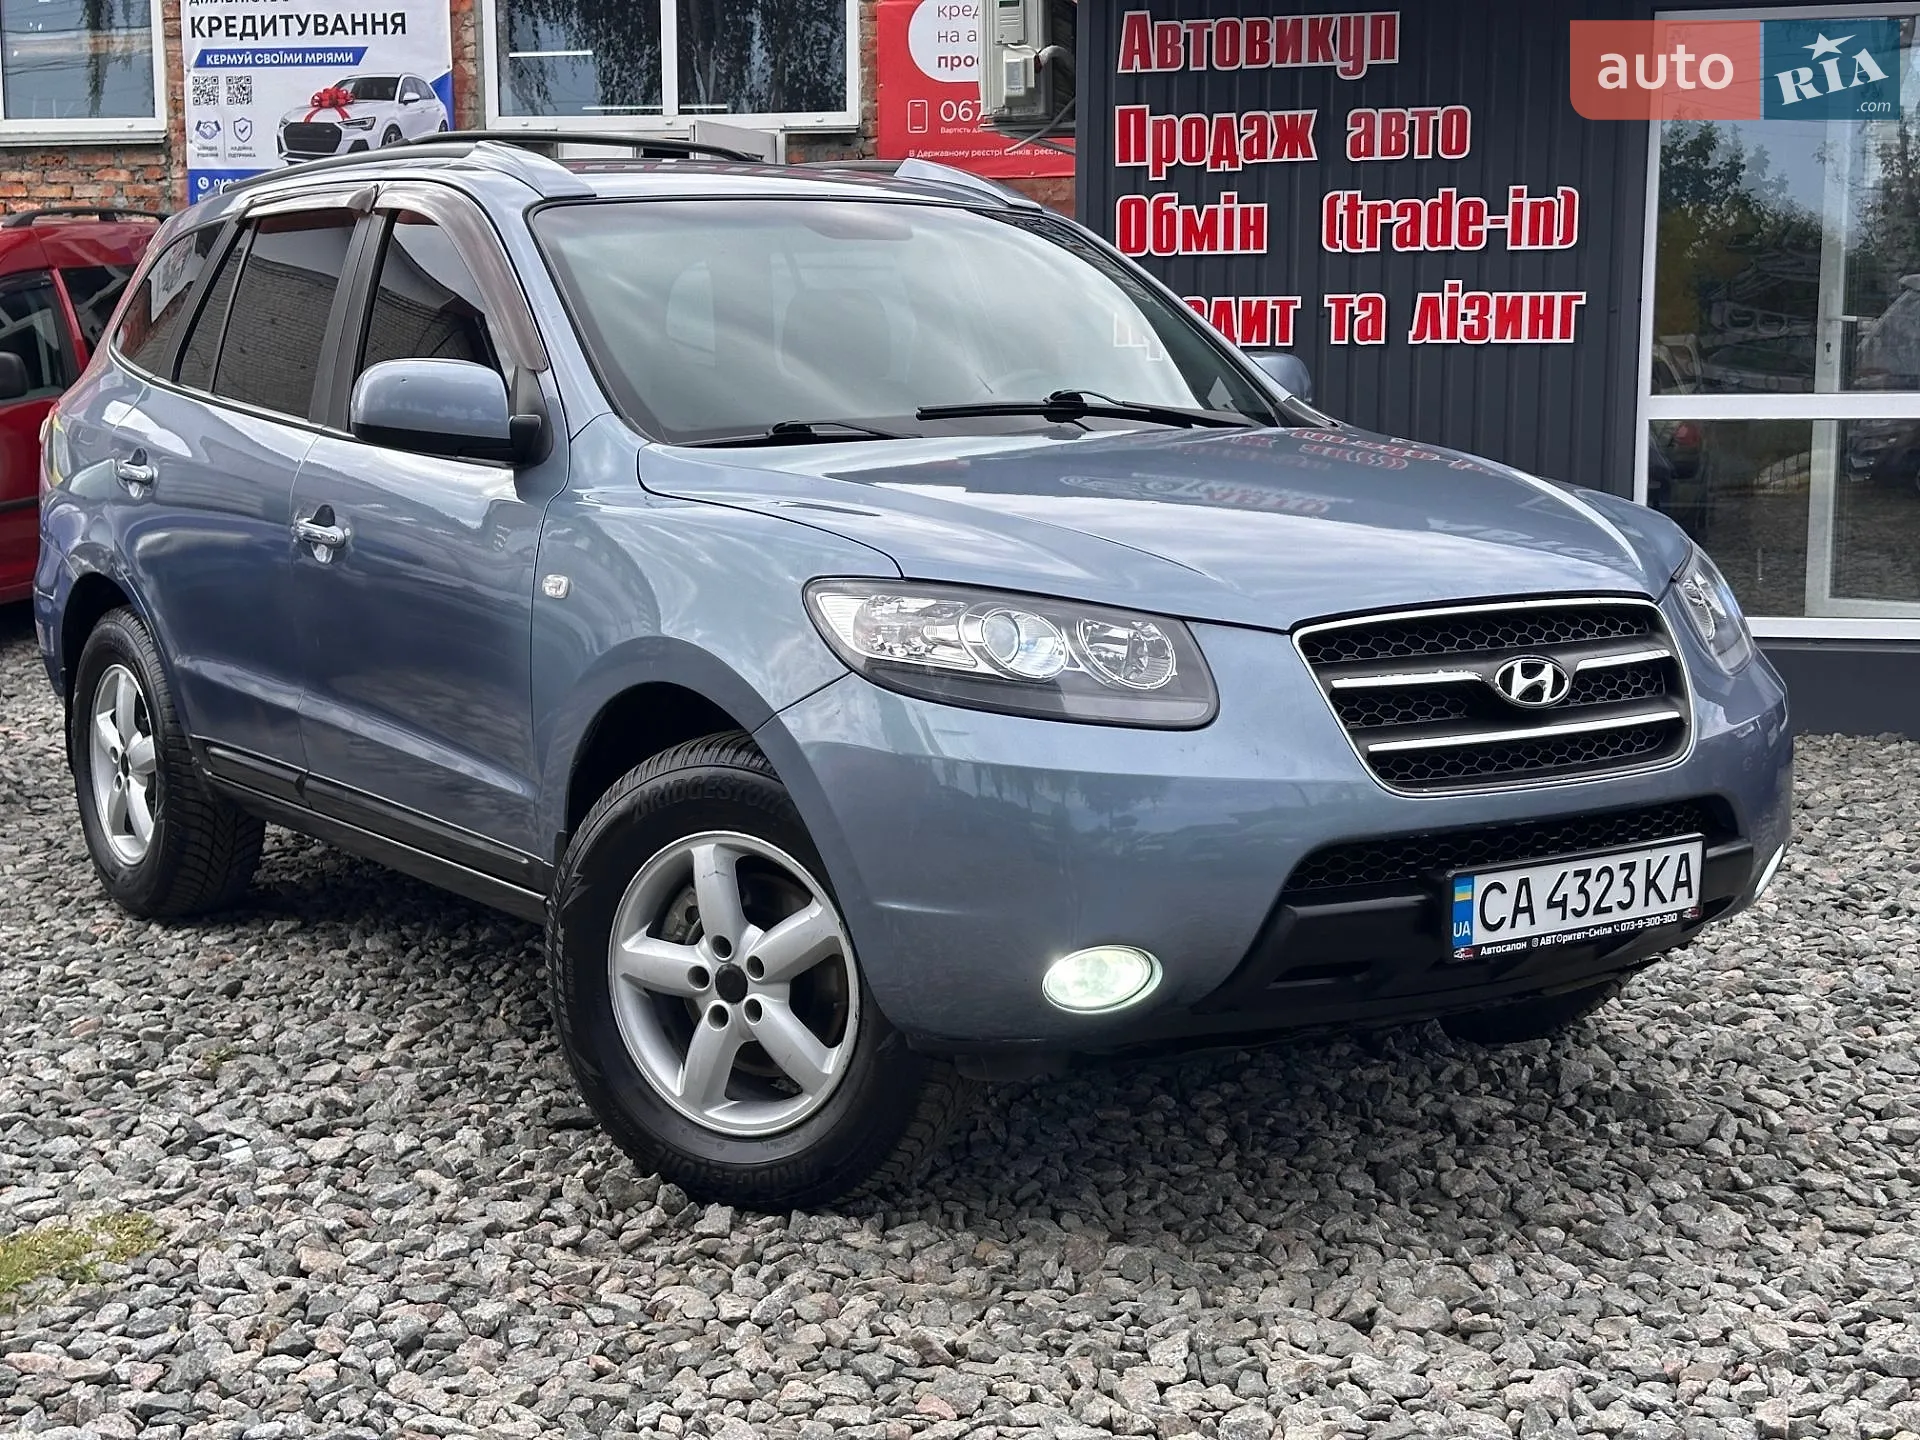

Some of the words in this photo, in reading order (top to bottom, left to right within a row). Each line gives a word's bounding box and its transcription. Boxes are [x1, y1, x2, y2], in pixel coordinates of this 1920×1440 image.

[190, 12, 407, 40] КРЕДИТУВАННЯ
[937, 31, 960, 43] на
[1117, 10, 1401, 80] Автовикуп
[206, 51, 252, 65] КЕРМУЙ
[255, 50, 303, 64] СВОЇМИ
[305, 52, 353, 64] МРІЯМИ
[937, 55, 979, 71] про
[1115, 104, 1318, 181] Продаж
[1346, 105, 1472, 162] авто
[1115, 191, 1268, 257] Обмін
[1322, 185, 1580, 254] (trade-in)
[1324, 292, 1386, 346] та
[1408, 280, 1586, 346] лізинг
[1479, 876, 1536, 932] CA
[1546, 860, 1637, 921] 4323
[1644, 852, 1693, 907] KA
[1453, 920, 1471, 938] UA
[1480, 941, 1527, 956] Автосалон
[1620, 912, 1678, 932] 073-9-300-300
